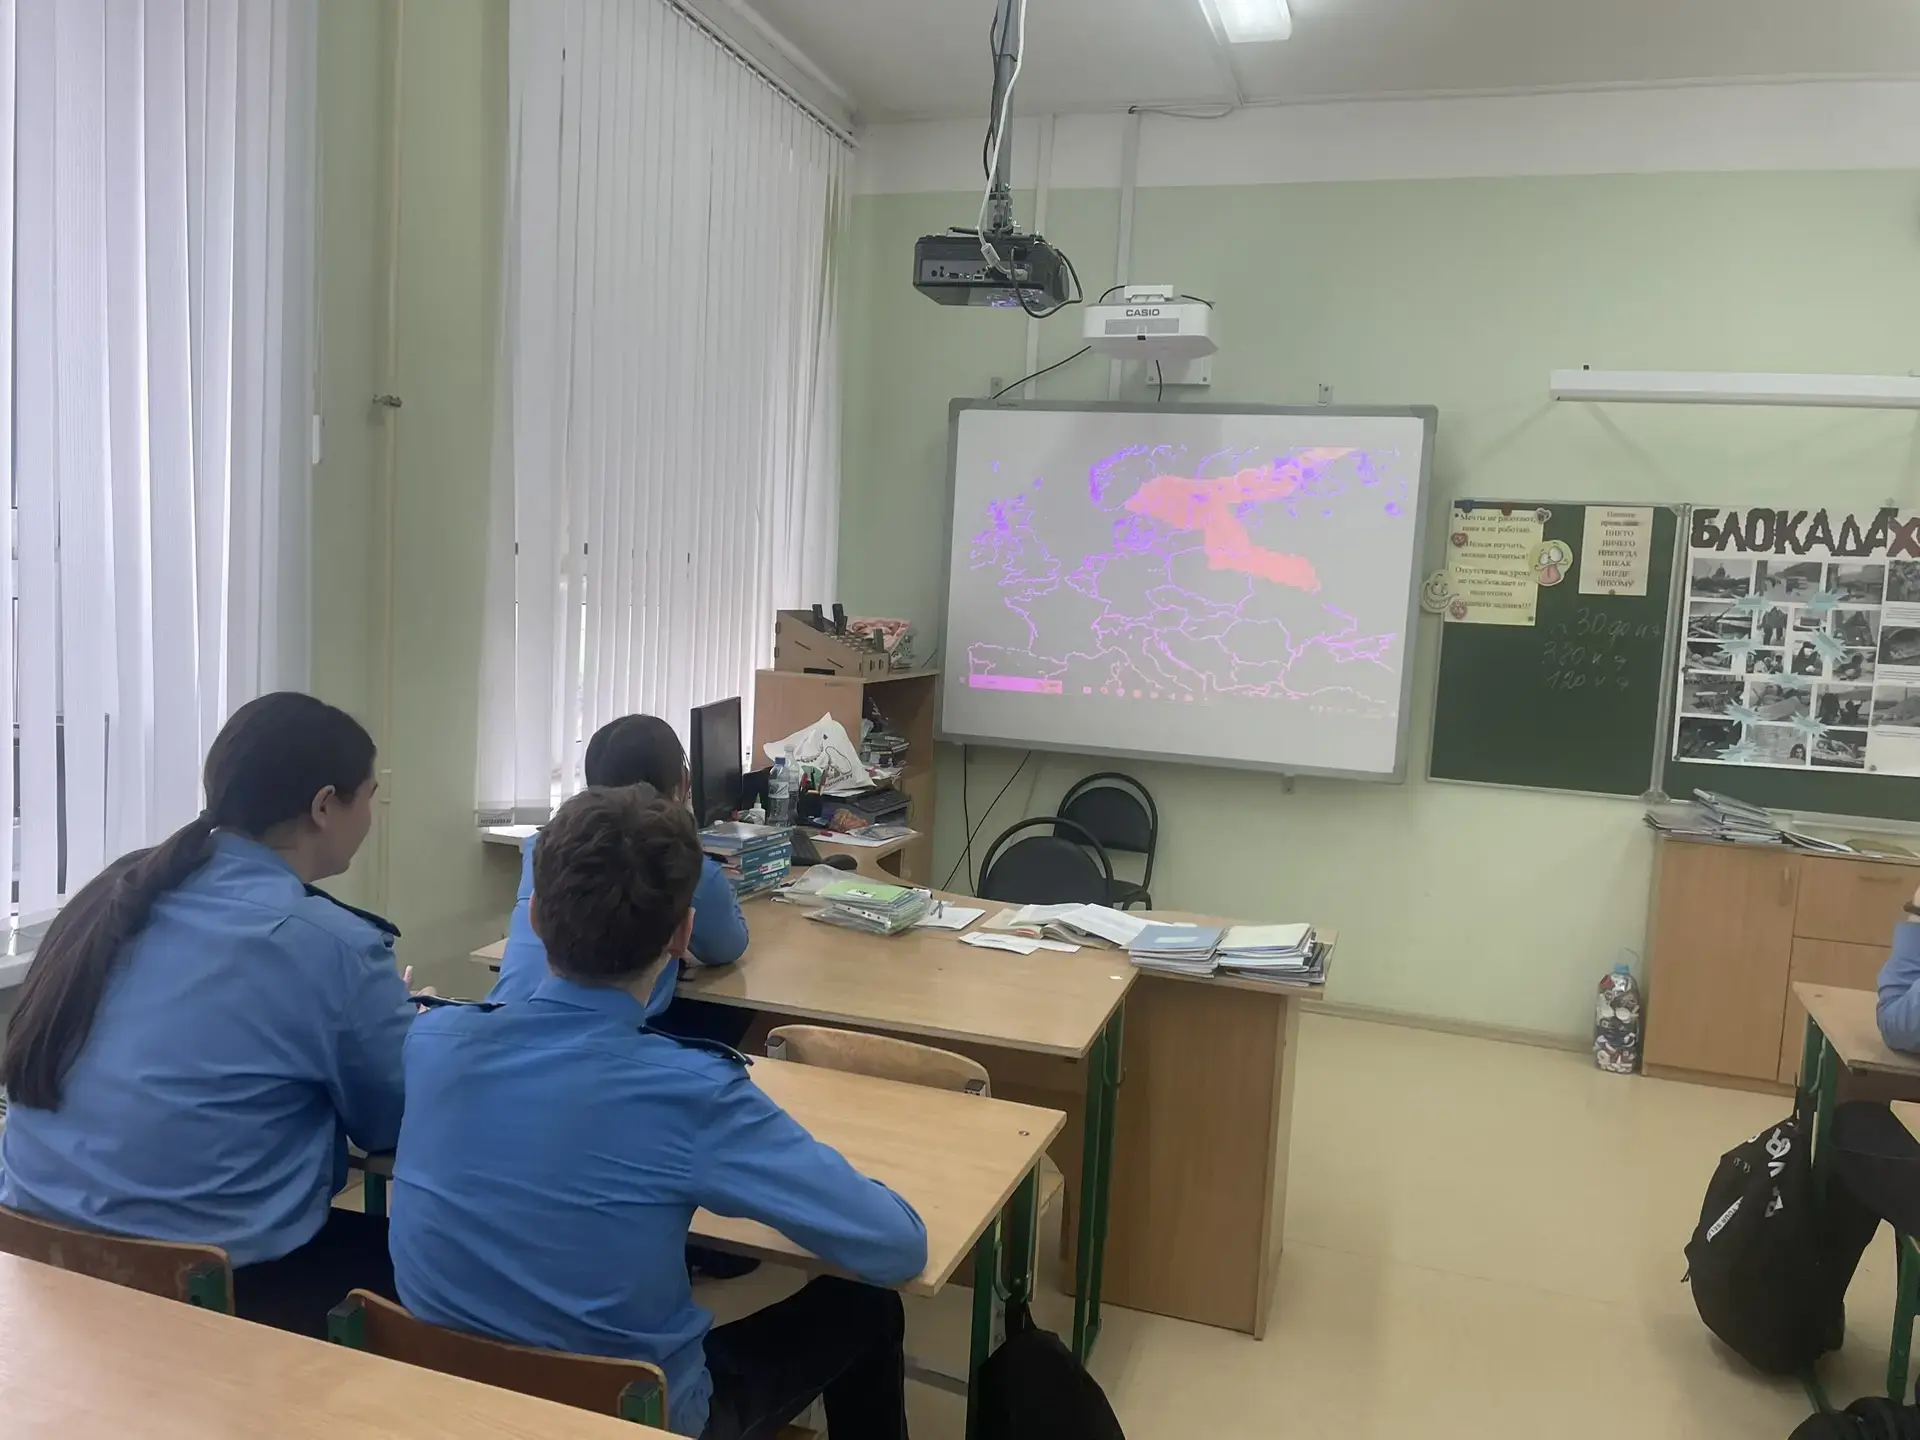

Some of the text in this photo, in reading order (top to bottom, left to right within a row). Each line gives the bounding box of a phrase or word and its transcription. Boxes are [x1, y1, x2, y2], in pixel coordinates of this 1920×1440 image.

[1125, 308, 1161, 317] CASIO
[1605, 529, 1635, 537] НИКТО
[1690, 507, 1899, 558] БЛОКАДА
[1886, 515, 1920, 558] Х
[1602, 539, 1636, 547] НИЧЕГО
[1597, 549, 1638, 558] НИКОГДА
[1602, 559, 1632, 567] НИКАК
[1597, 579, 1635, 588] НИКОМУ
[1577, 607, 1607, 636] 30
